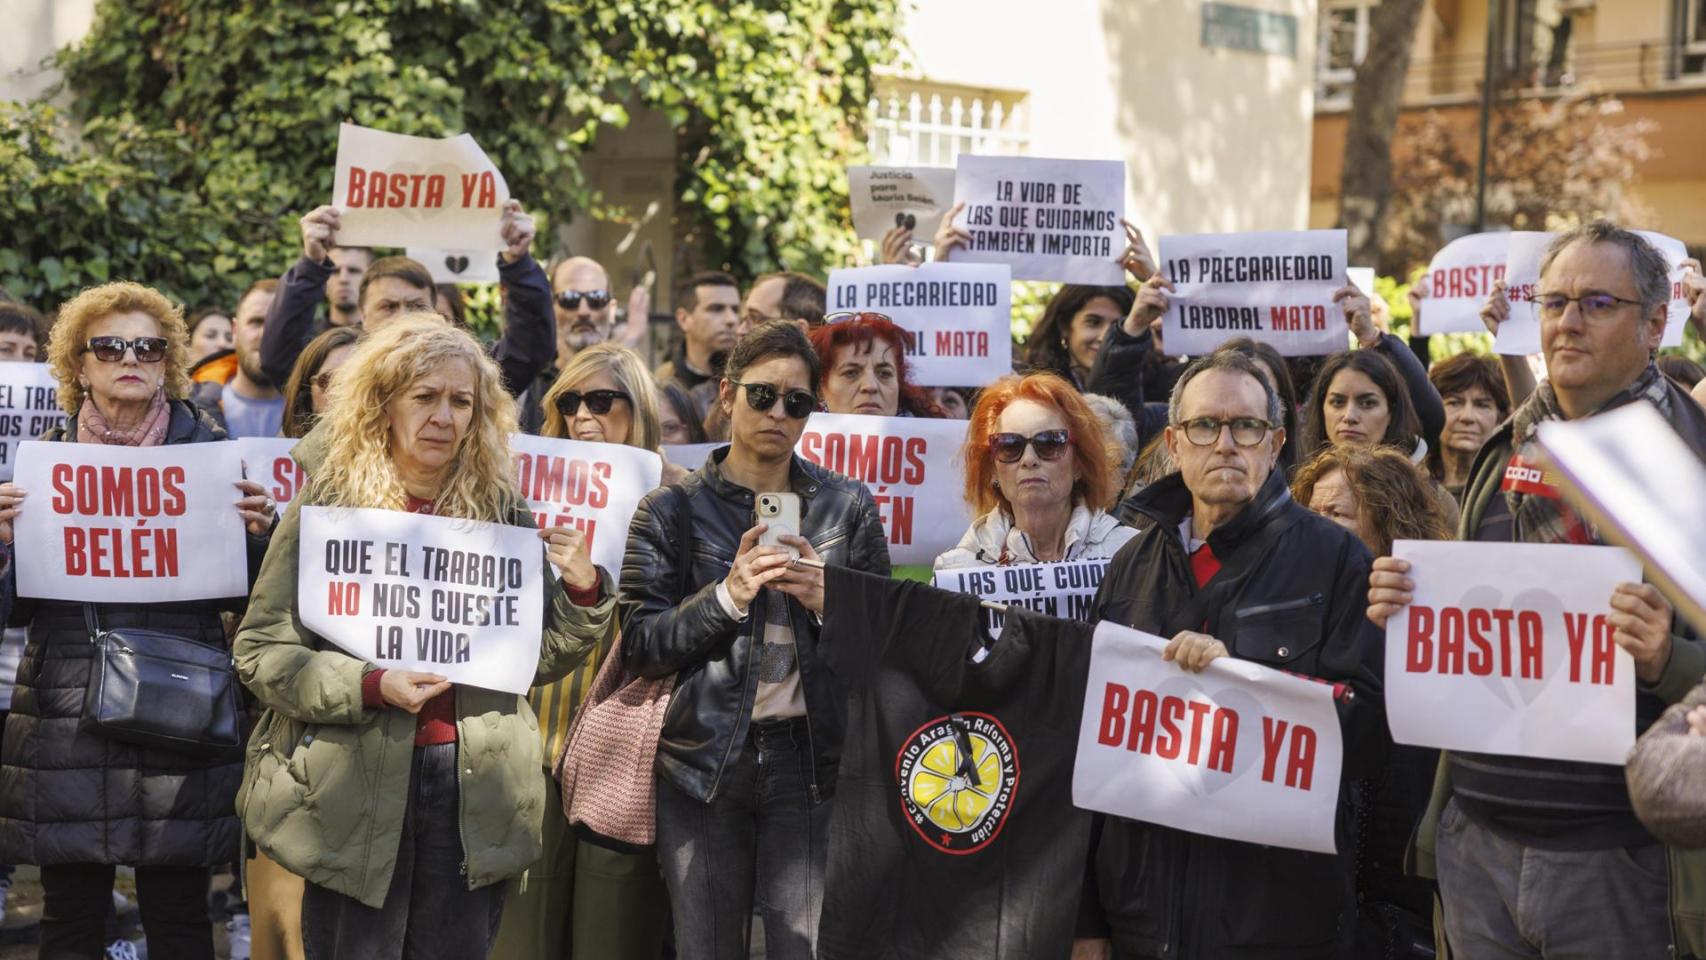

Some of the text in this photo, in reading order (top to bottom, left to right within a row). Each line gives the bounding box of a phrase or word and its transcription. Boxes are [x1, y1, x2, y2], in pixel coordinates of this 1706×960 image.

[346, 166, 496, 209] BASTA YA
[870, 170, 913, 180] Justicia
[870, 184, 897, 194] para
[996, 180, 1082, 205] LA VIDA DE
[967, 205, 1115, 231] LAS QUE CUIDAMOS
[969, 228, 1110, 257] TAMBIÉN IMPORTA
[1168, 255, 1332, 284] LA PRECARIEDAD
[836, 281, 997, 309] LA PRECARIEDAD
[1180, 305, 1326, 331] LABORAL MATA
[936, 331, 988, 357] MATA
[52, 463, 186, 517] SOMOS
[518, 453, 612, 509] OMOS
[63, 519, 179, 577] BELÉN
[325, 539, 523, 593] QUE EL TRABAJO
[959, 571, 996, 595] LAS
[1005, 567, 1046, 594] QUE
[328, 581, 520, 627] NO NOS CUESTE
[376, 625, 470, 664] LA VIDA
[1406, 605, 1616, 685] BASTA YA
[1098, 681, 1318, 791] BASTA YA
[900, 745, 924, 825] #Cnvenio
[920, 720, 970, 746] Aragn
[974, 718, 1012, 763] Reforma
